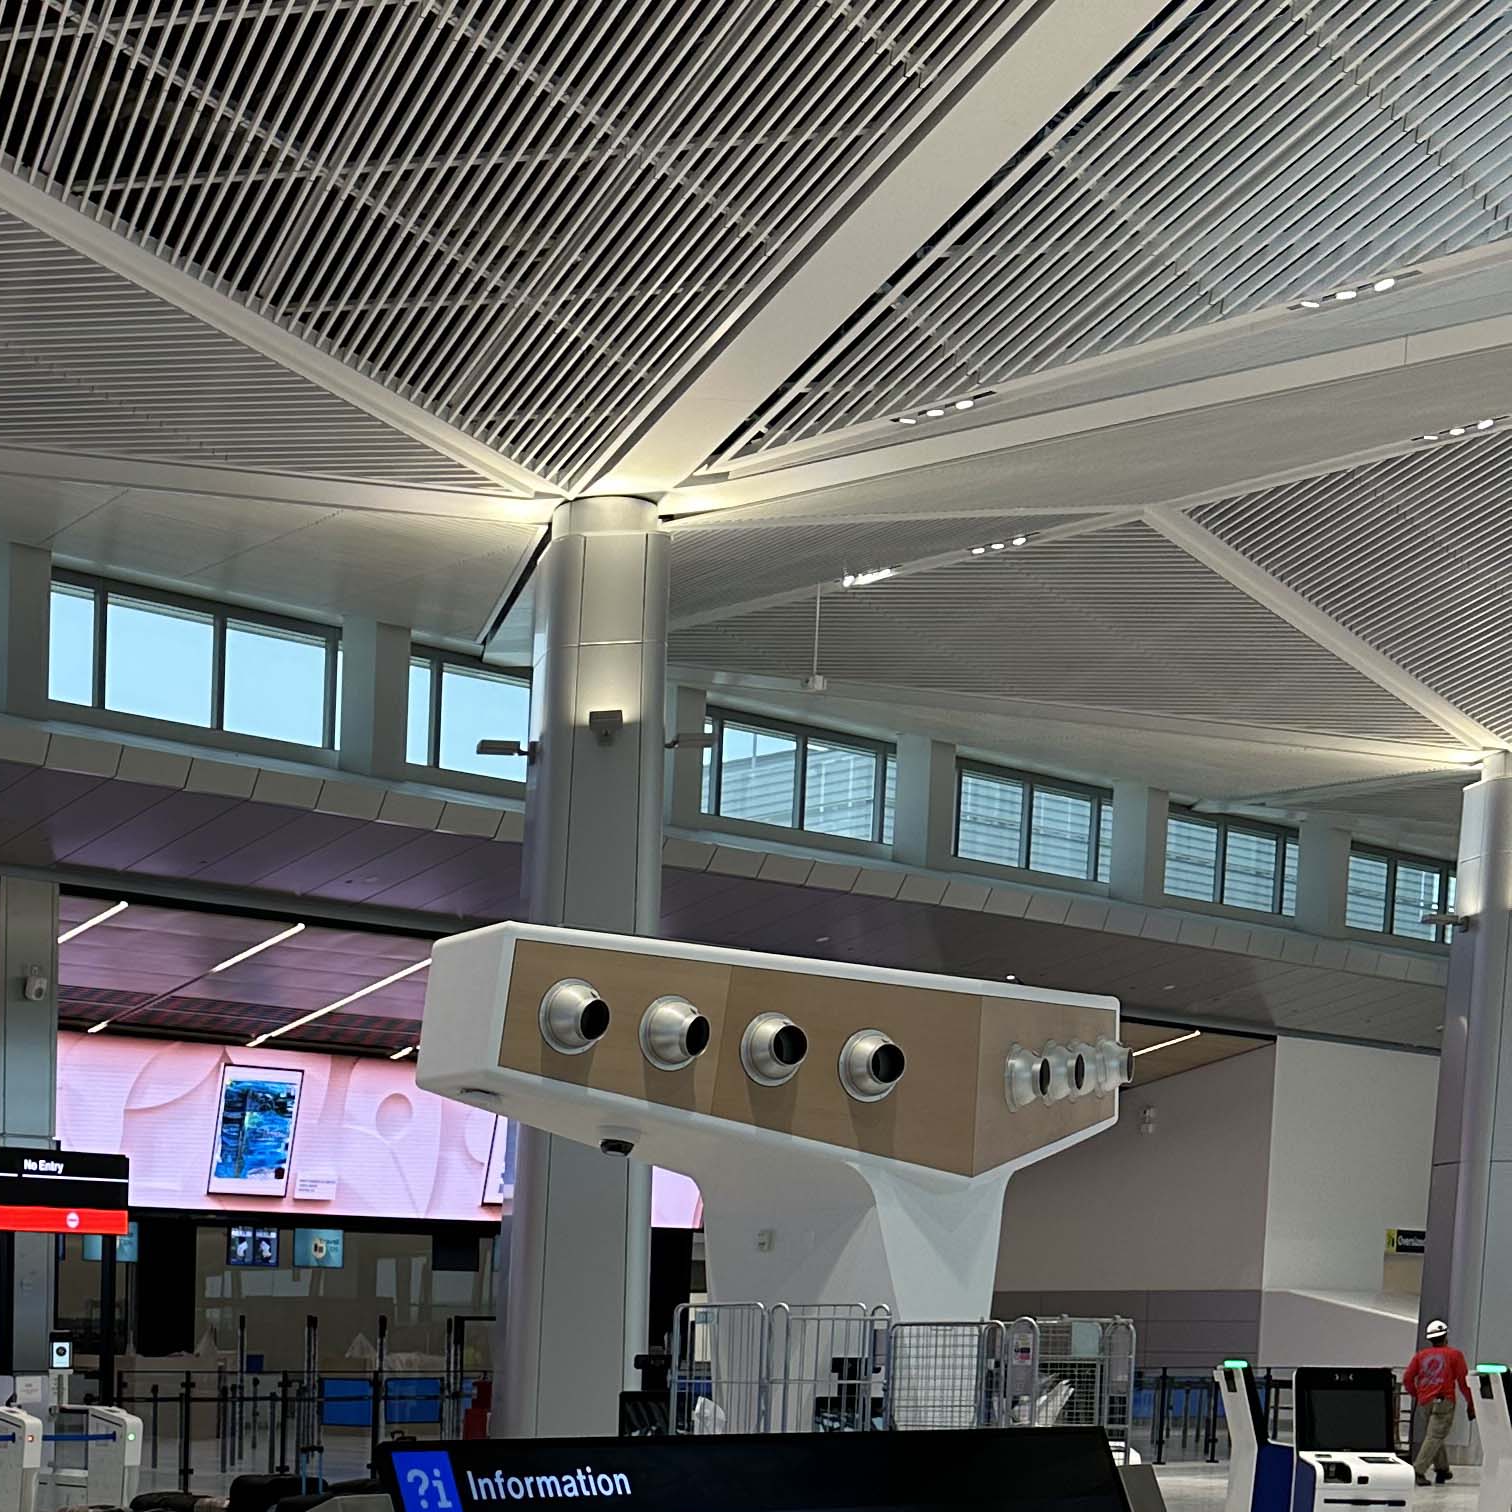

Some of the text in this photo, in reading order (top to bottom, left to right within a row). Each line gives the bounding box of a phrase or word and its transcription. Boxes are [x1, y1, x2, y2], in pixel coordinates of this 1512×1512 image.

[23, 1159, 64, 1175] No Entry
[466, 1466, 632, 1501] Information
